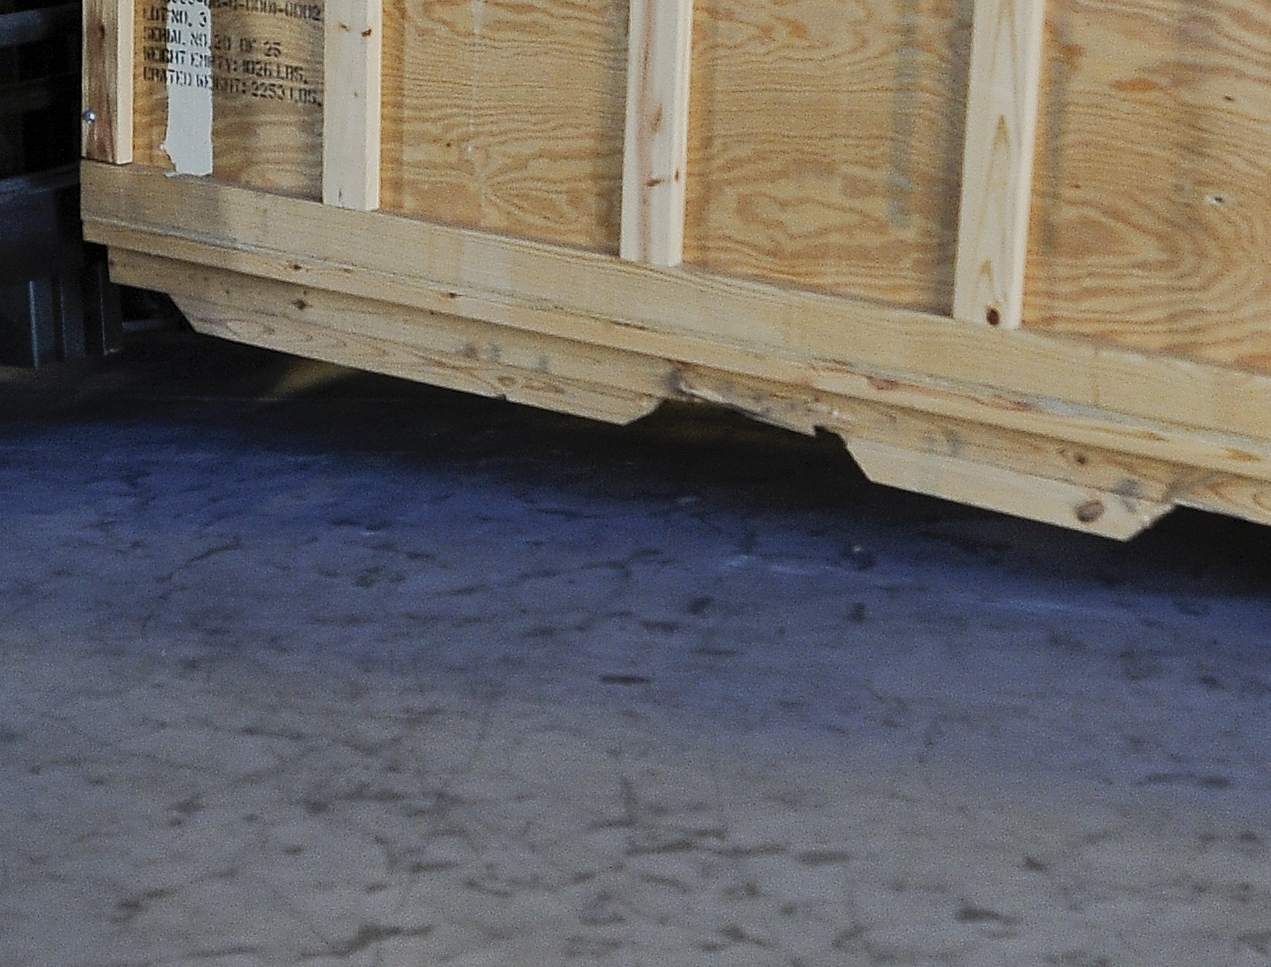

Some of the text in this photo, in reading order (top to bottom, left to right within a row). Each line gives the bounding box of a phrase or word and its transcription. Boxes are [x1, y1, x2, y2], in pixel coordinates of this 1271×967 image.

[142, 6, 208, 27] LOT NO. 3
[142, 26, 186, 46] SERIAL
[239, 37, 257, 54] OF
[263, 41, 281, 57] 25
[142, 45, 186, 65] WEIGHT
[142, 66, 193, 87] CRATED
